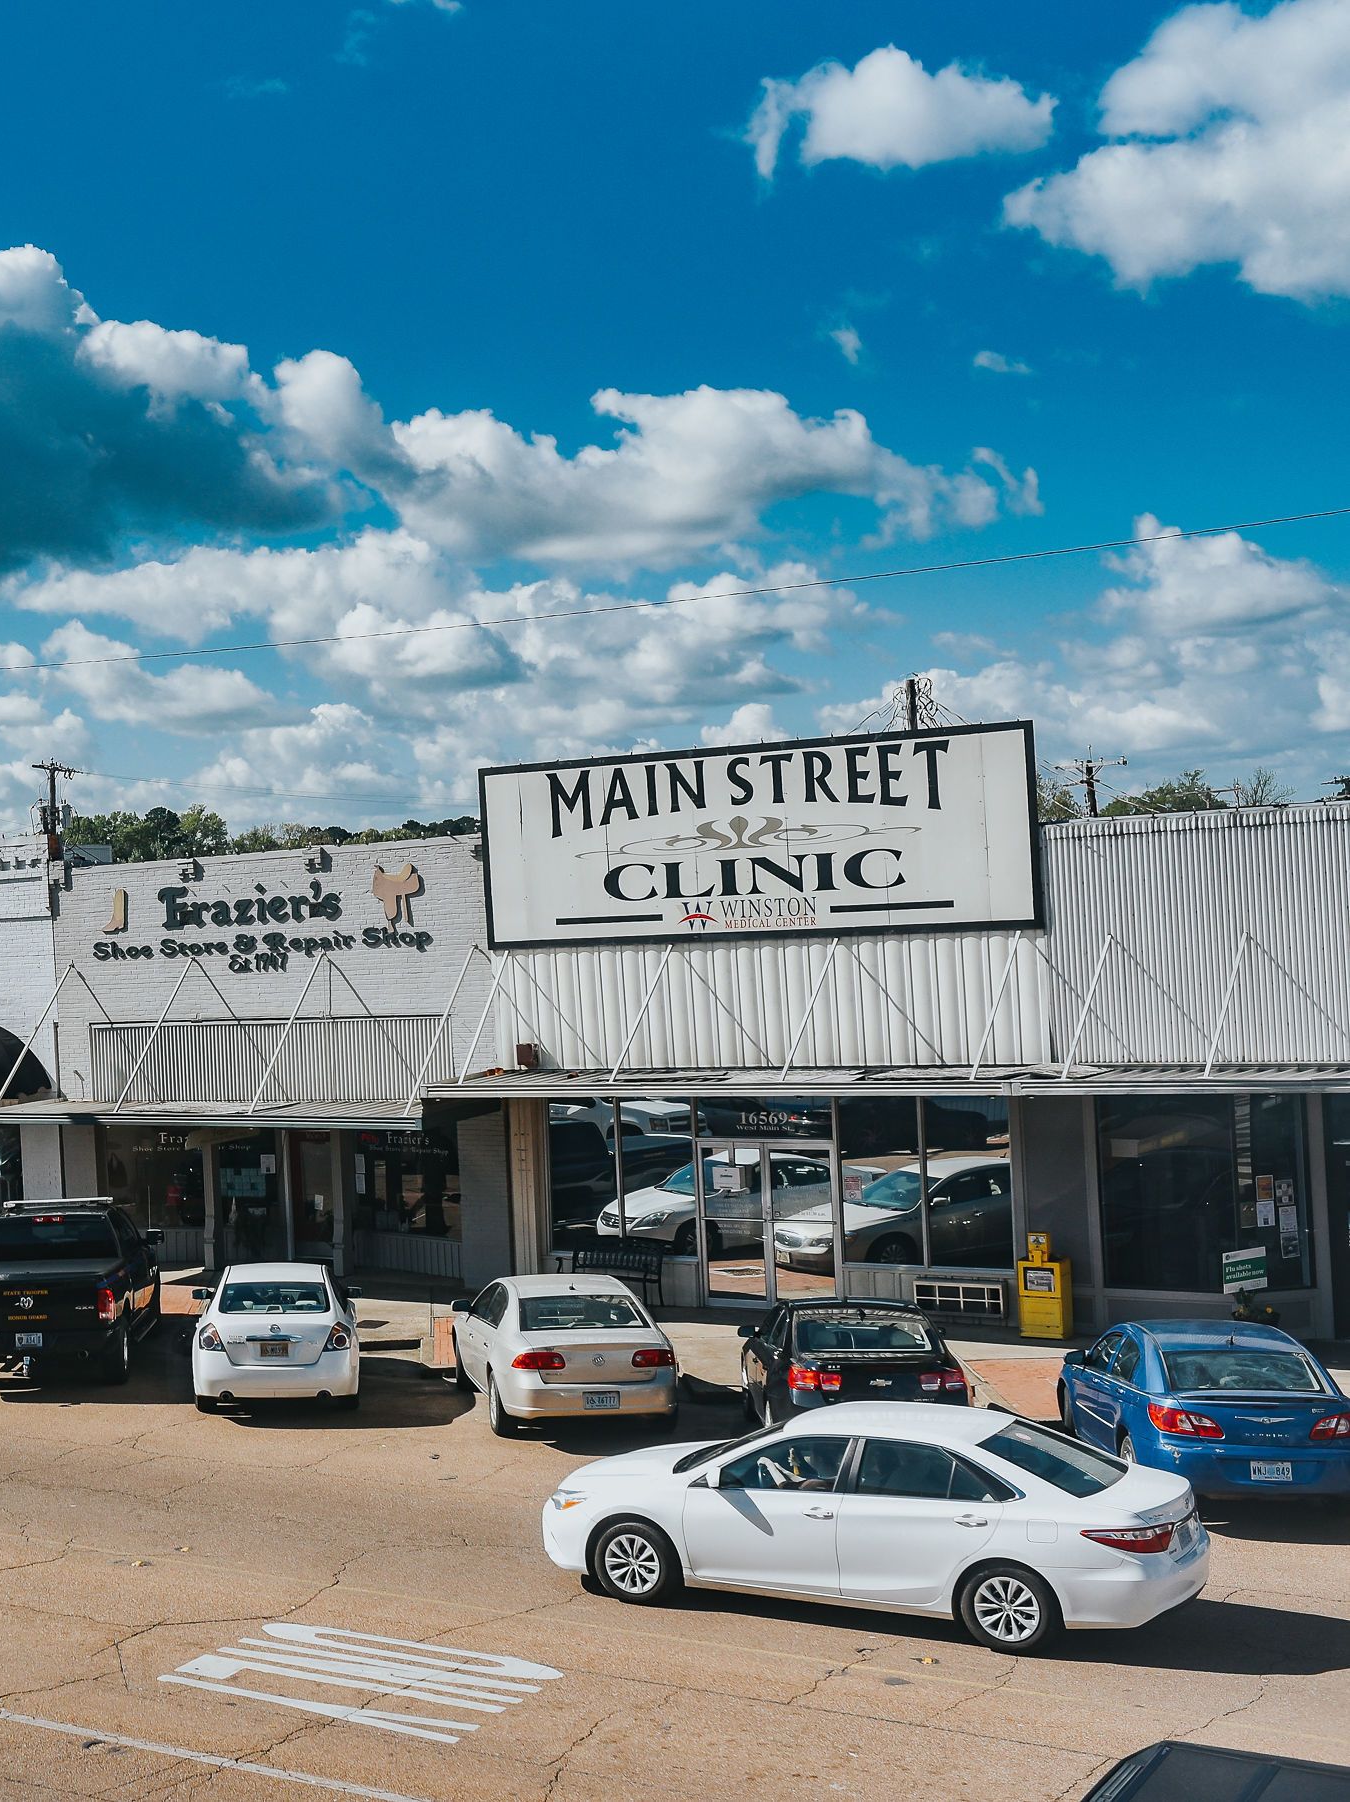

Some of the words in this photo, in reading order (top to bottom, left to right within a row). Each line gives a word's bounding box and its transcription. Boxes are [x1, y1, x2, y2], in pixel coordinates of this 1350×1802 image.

[546, 760, 708, 839] MAIN
[727, 739, 950, 811] STREET
[603, 848, 906, 901] CLINIC
[157, 880, 343, 931] Frazier's
[720, 896, 817, 919] WINSTON
[725, 918, 771, 929] MEDICAL
[775, 916, 817, 928] CENTER
[92, 941, 155, 962] Shoe
[159, 938, 230, 959] Store
[233, 933, 257, 954] &
[262, 930, 357, 958] Repair
[361, 926, 434, 953] Shop
[253, 952, 289, 973] 1947
[739, 1111, 788, 1125] 16569
[386, 1131, 430, 1146] Frazier's
[1225, 1265, 1235, 1273] Flu
[1225, 1271, 1251, 1280] available
[1252, 1465, 1267, 1476] WNJ
[1276, 1466, 1291, 1476] 849
